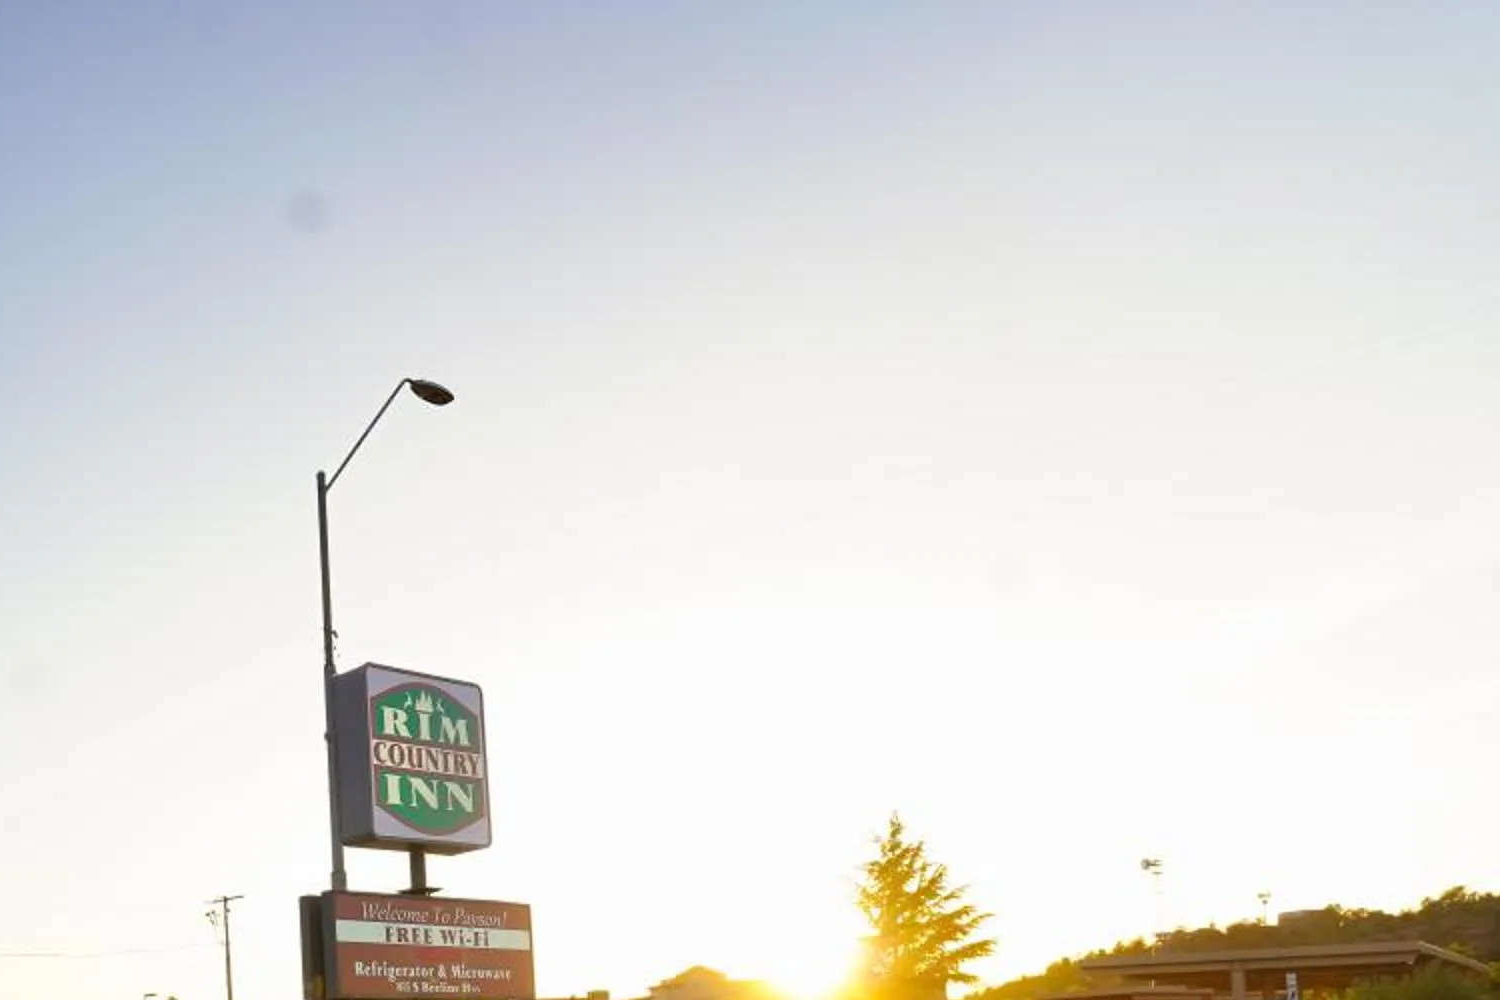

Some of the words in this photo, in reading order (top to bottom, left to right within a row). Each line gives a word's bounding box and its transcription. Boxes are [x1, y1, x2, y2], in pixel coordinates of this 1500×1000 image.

[382, 705, 471, 747] RIM
[373, 741, 480, 778] COUNTRY
[381, 773, 474, 813] INN
[361, 901, 427, 923] Welcome
[433, 907, 449, 924] To
[453, 908, 508, 929] Payson!
[384, 926, 433, 945] FREE
[439, 930, 490, 947] Wi-Fi
[355, 961, 435, 982] Refrigerator
[437, 965, 447, 978] &
[451, 964, 511, 980] Microwave
